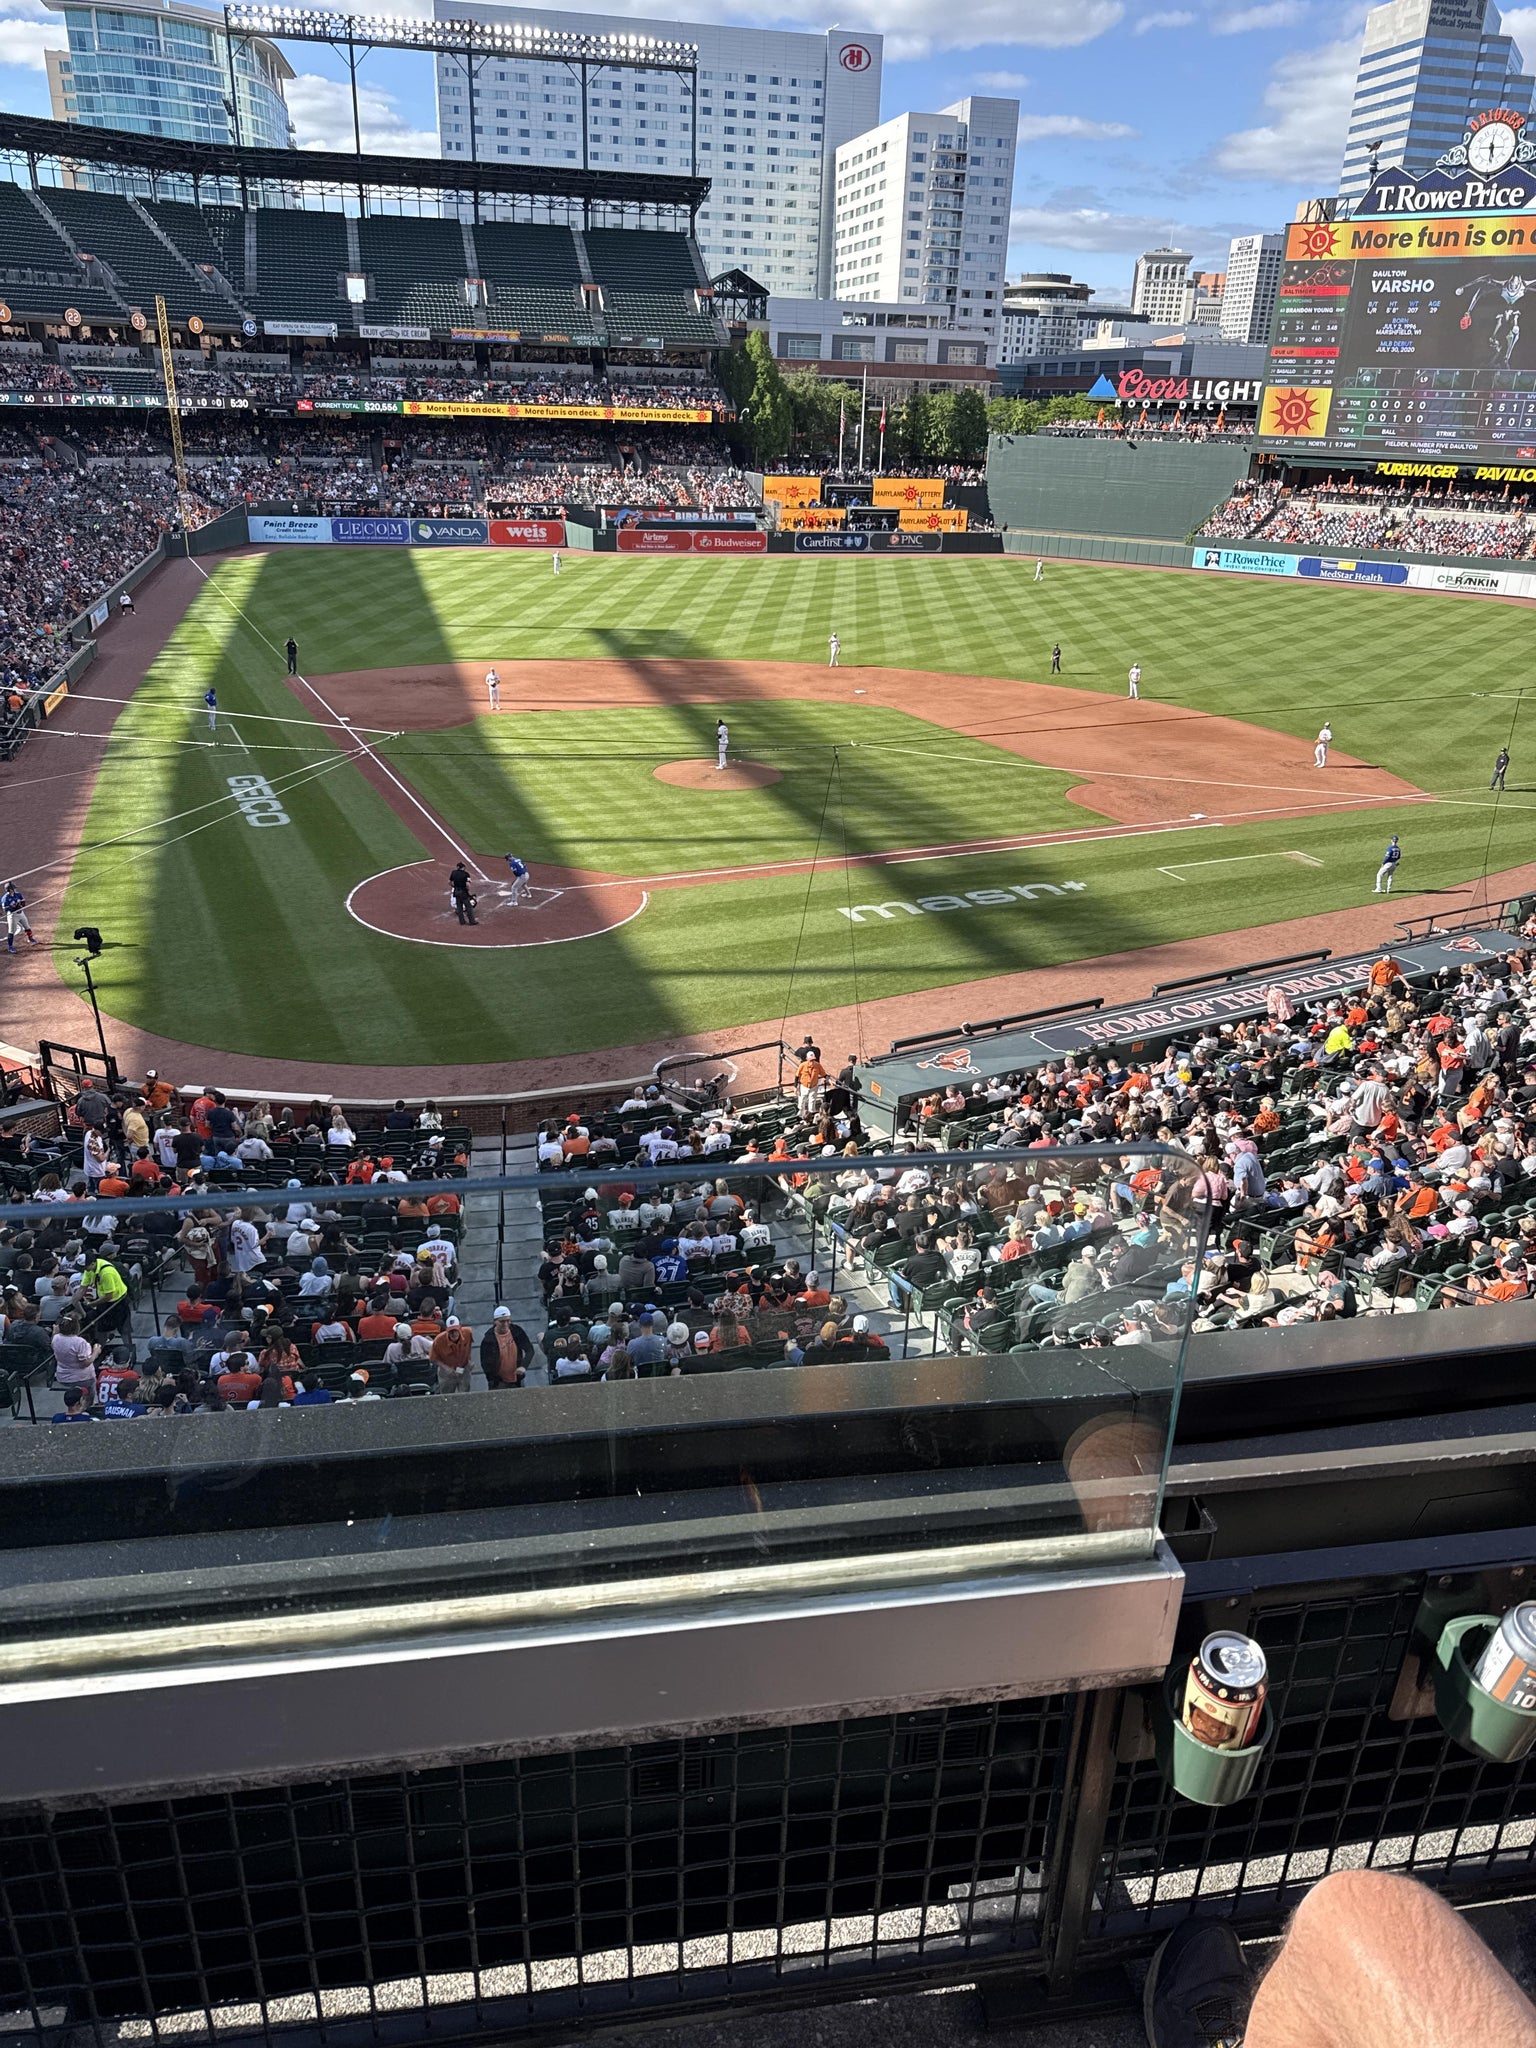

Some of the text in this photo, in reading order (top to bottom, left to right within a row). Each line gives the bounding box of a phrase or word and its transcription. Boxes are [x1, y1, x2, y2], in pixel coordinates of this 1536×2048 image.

[1431, 6, 1472, 18] of Maryland
[1429, 16, 1482, 29] Medical System
[1470, 107, 1526, 131] ORIOLES
[1461, 181, 1525, 208] Price
[1350, 230, 1413, 249] More
[1417, 226, 1460, 248] fun
[1464, 224, 1487, 247] is
[1491, 228, 1525, 246] on
[1372, 270, 1407, 278] DAULTON
[1371, 279, 1435, 293] VARSHO
[67, 313, 255, 333] 22 33 8 42
[410, 330, 428, 338] CREAM
[1118, 368, 1262, 400] Coors LIGHT
[24, 394, 35, 403] 60
[48, 394, 54, 403] 5
[98, 396, 115, 405] TOR
[121, 396, 128, 405] 2
[144, 396, 161, 406] BAL
[186, 399, 192, 407] 0
[201, 399, 207, 407] 0
[230, 399, 249, 408] 5:30
[341, 402, 360, 410] TOTAL
[364, 402, 398, 412] $20,556
[1114, 399, 1230, 410] ROOF DECK
[1370, 401, 1377, 409] 0
[1381, 401, 1389, 409] 0
[1393, 401, 1400, 409] 0
[1407, 401, 1414, 409] 2
[1419, 402, 1426, 410] 0
[1485, 403, 1493, 411] 2
[1498, 403, 1505, 411] 5
[1528, 404, 1536, 412] 2
[426, 404, 448, 412] More
[449, 405, 461, 413] fun
[481, 406, 504, 414] deck.
[524, 408, 544, 416] More
[545, 408, 558, 417] fun
[559, 409, 566, 417] is
[578, 409, 600, 417] deck.
[640, 410, 653, 418] fun
[655, 411, 661, 419] is
[672, 411, 693, 420] deck.
[1367, 414, 1375, 422] 0
[1379, 414, 1387, 422] 0
[1404, 415, 1412, 423] 0
[1416, 415, 1424, 423] 0
[1495, 418, 1503, 426] 2
[1508, 418, 1516, 426] 0
[1525, 418, 1532, 427] 3
[1385, 440, 1410, 448] FIELDER,
[1374, 462, 1460, 479] PUREWAGER
[675, 512, 699, 521] BIRD
[701, 512, 727, 521] BATH
[338, 523, 403, 536] LECOM
[432, 527, 482, 537] VANDA
[506, 524, 548, 539] weis
[642, 533, 669, 542] Airtemp
[714, 538, 757, 547] Budweiser
[802, 535, 843, 547] CareFirst
[900, 535, 923, 545] PNC
[1259, 555, 1285, 568] Price
[1320, 570, 1383, 583] MedStar Health
[1437, 575, 1499, 588] CP RANKIN
[226, 774, 291, 828] GEICO
[1075, 1008, 1173, 1040] HOME
[1170, 997, 1214, 1020] OF
[1210, 987, 1269, 1012] THE
[420, 1155, 437, 1167] 52
[655, 1265, 679, 1282] 27
[961, 1264, 968, 1275] 9
[105, 1406, 135, 1418] GAUSMAN
[1238, 1693, 1251, 1701] IPA
